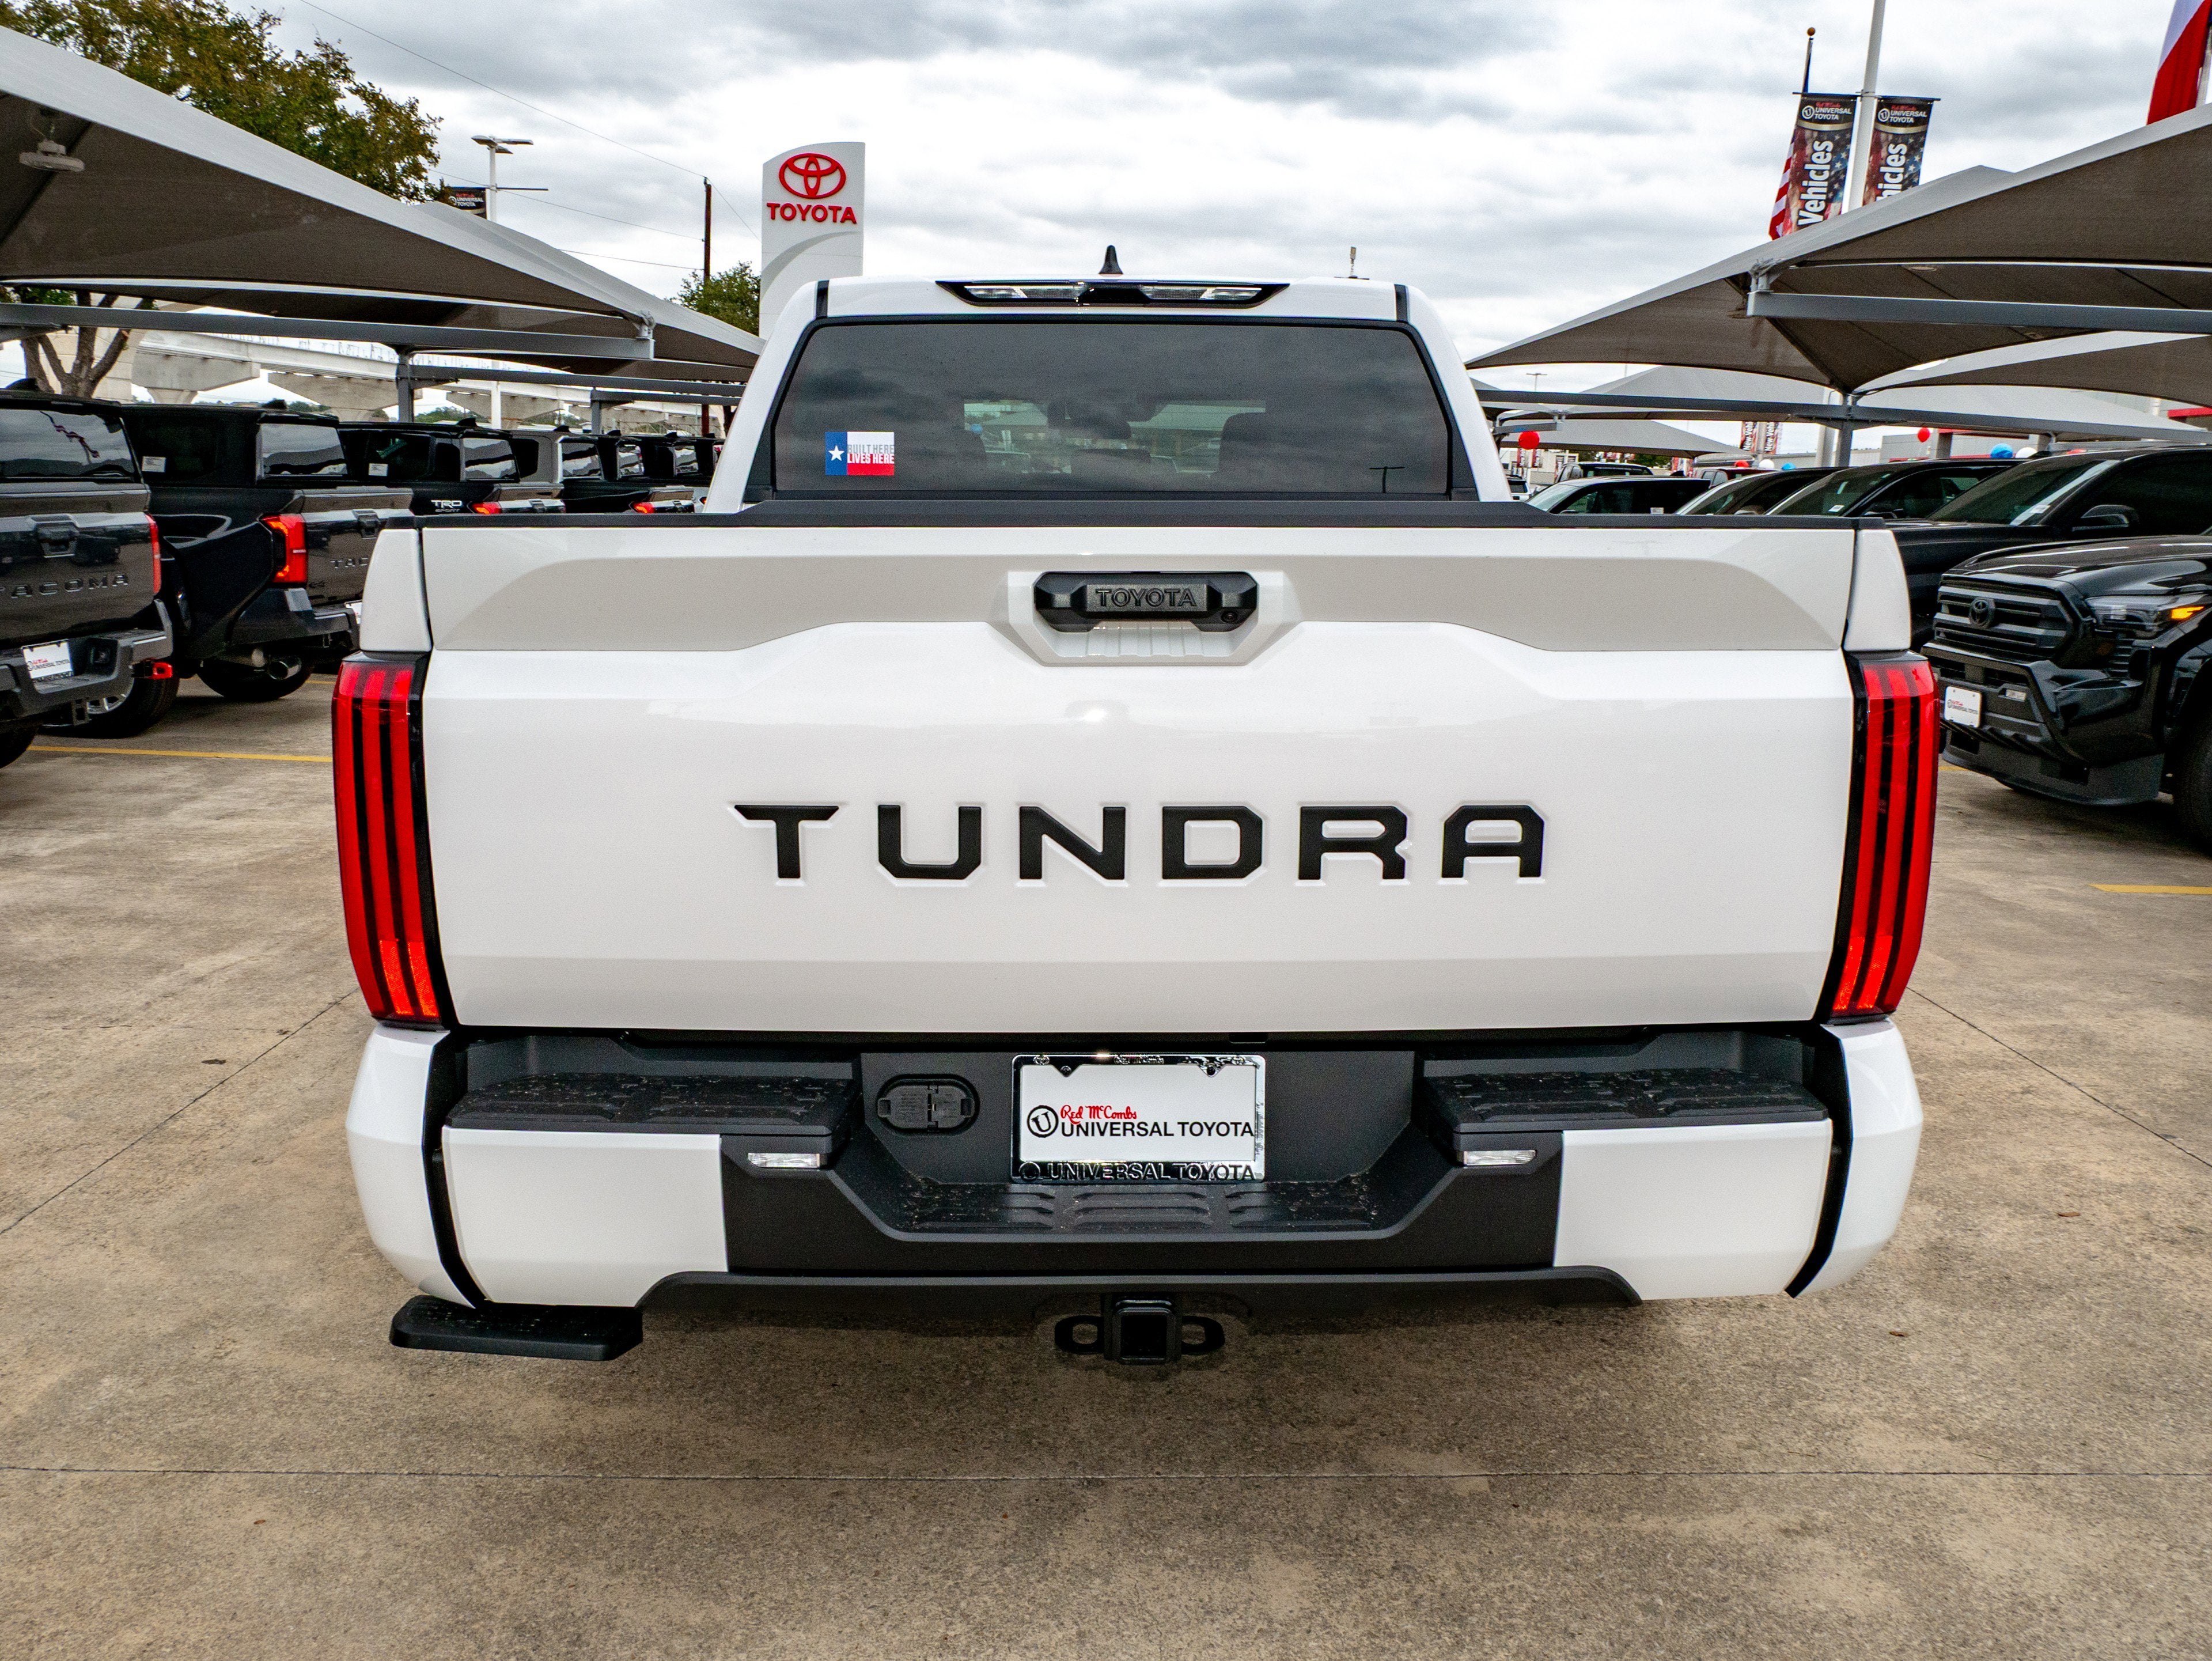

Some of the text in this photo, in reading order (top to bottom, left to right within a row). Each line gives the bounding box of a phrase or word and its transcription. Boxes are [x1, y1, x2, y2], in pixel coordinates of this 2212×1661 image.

[1797, 140, 1834, 226] Vehicles
[767, 203, 857, 224] TOYOTA
[847, 444, 895, 454] BUILT HERE
[1743, 436, 1752, 451] New
[1764, 437, 1774, 452] New
[847, 453, 895, 464] LIVES HERE
[431, 500, 462, 509] TRD
[0, 574, 129, 599] ACOMA
[1096, 588, 1197, 607] TOYOTA
[733, 804, 1545, 879] TUNDRA
[1060, 1104, 1137, 1125] Red McCombs
[1062, 1121, 1255, 1137] UNIVERSAL TOYOTA
[1047, 1162, 1257, 1181] UNIVERSAL TOYOTA
